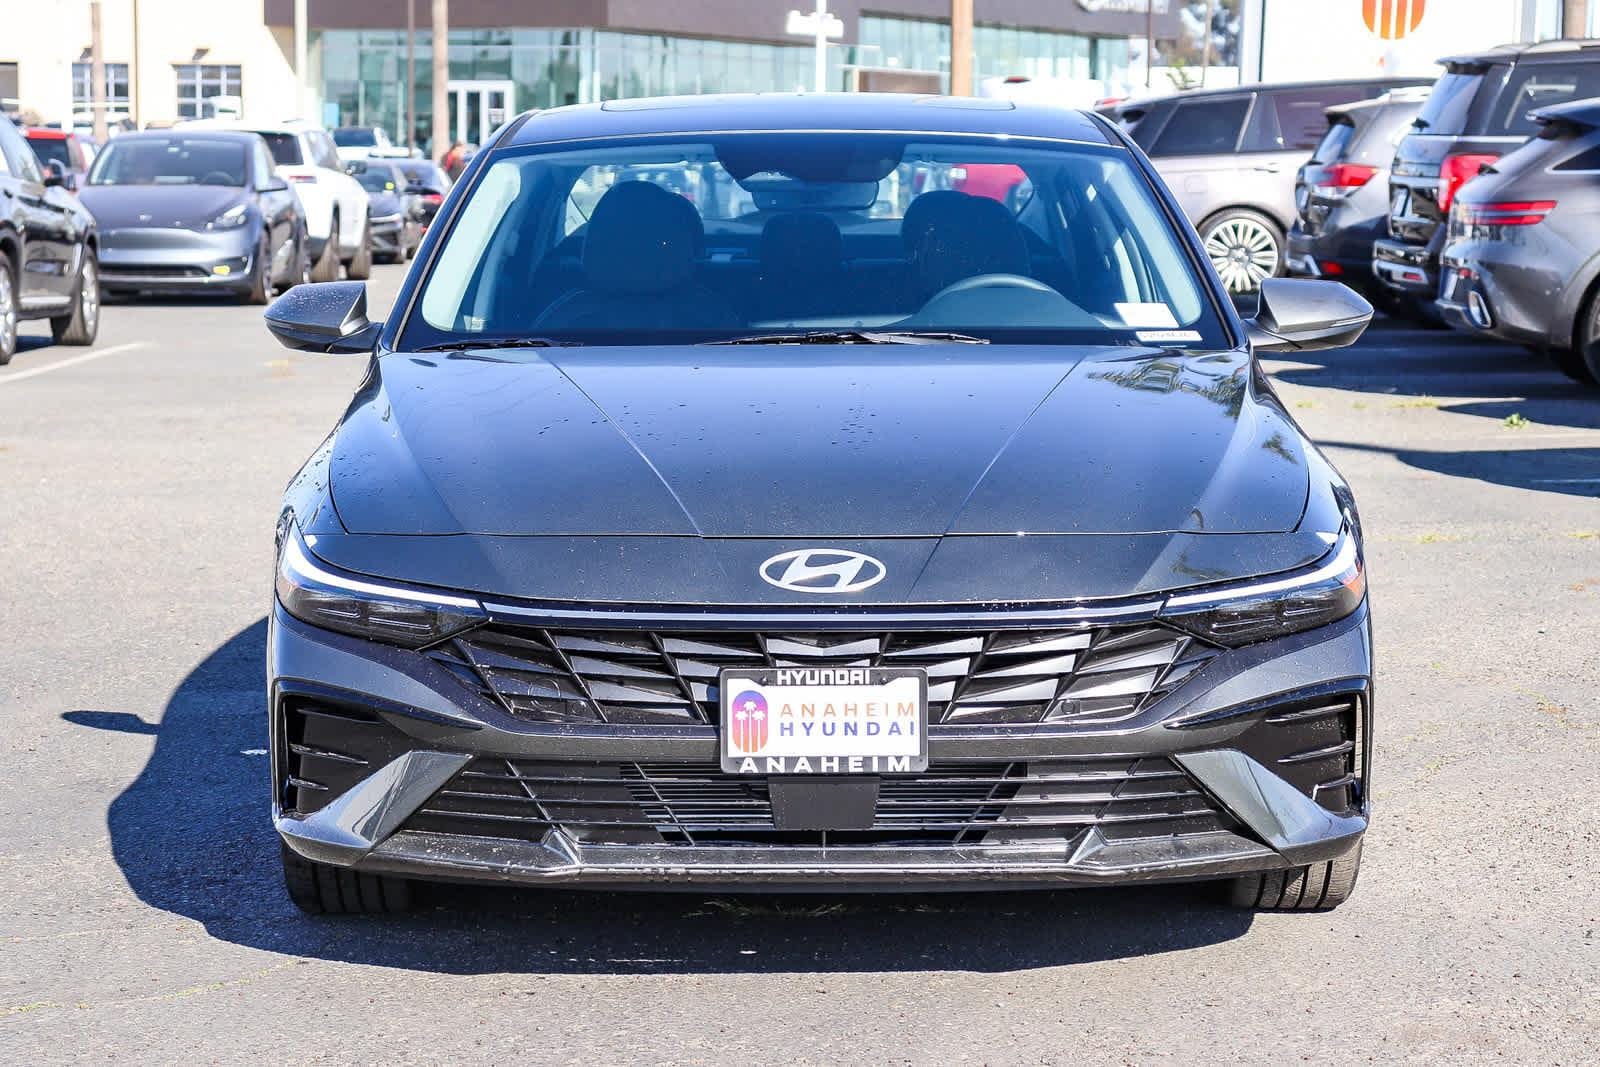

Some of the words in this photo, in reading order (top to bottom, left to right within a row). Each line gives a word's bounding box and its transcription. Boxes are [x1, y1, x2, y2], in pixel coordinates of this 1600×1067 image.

[776, 669, 870, 685] HYUNDAI
[780, 702, 914, 718] ANAHEIM
[780, 721, 914, 736] HYUNDAI
[739, 756, 910, 773] ANAHEIM
